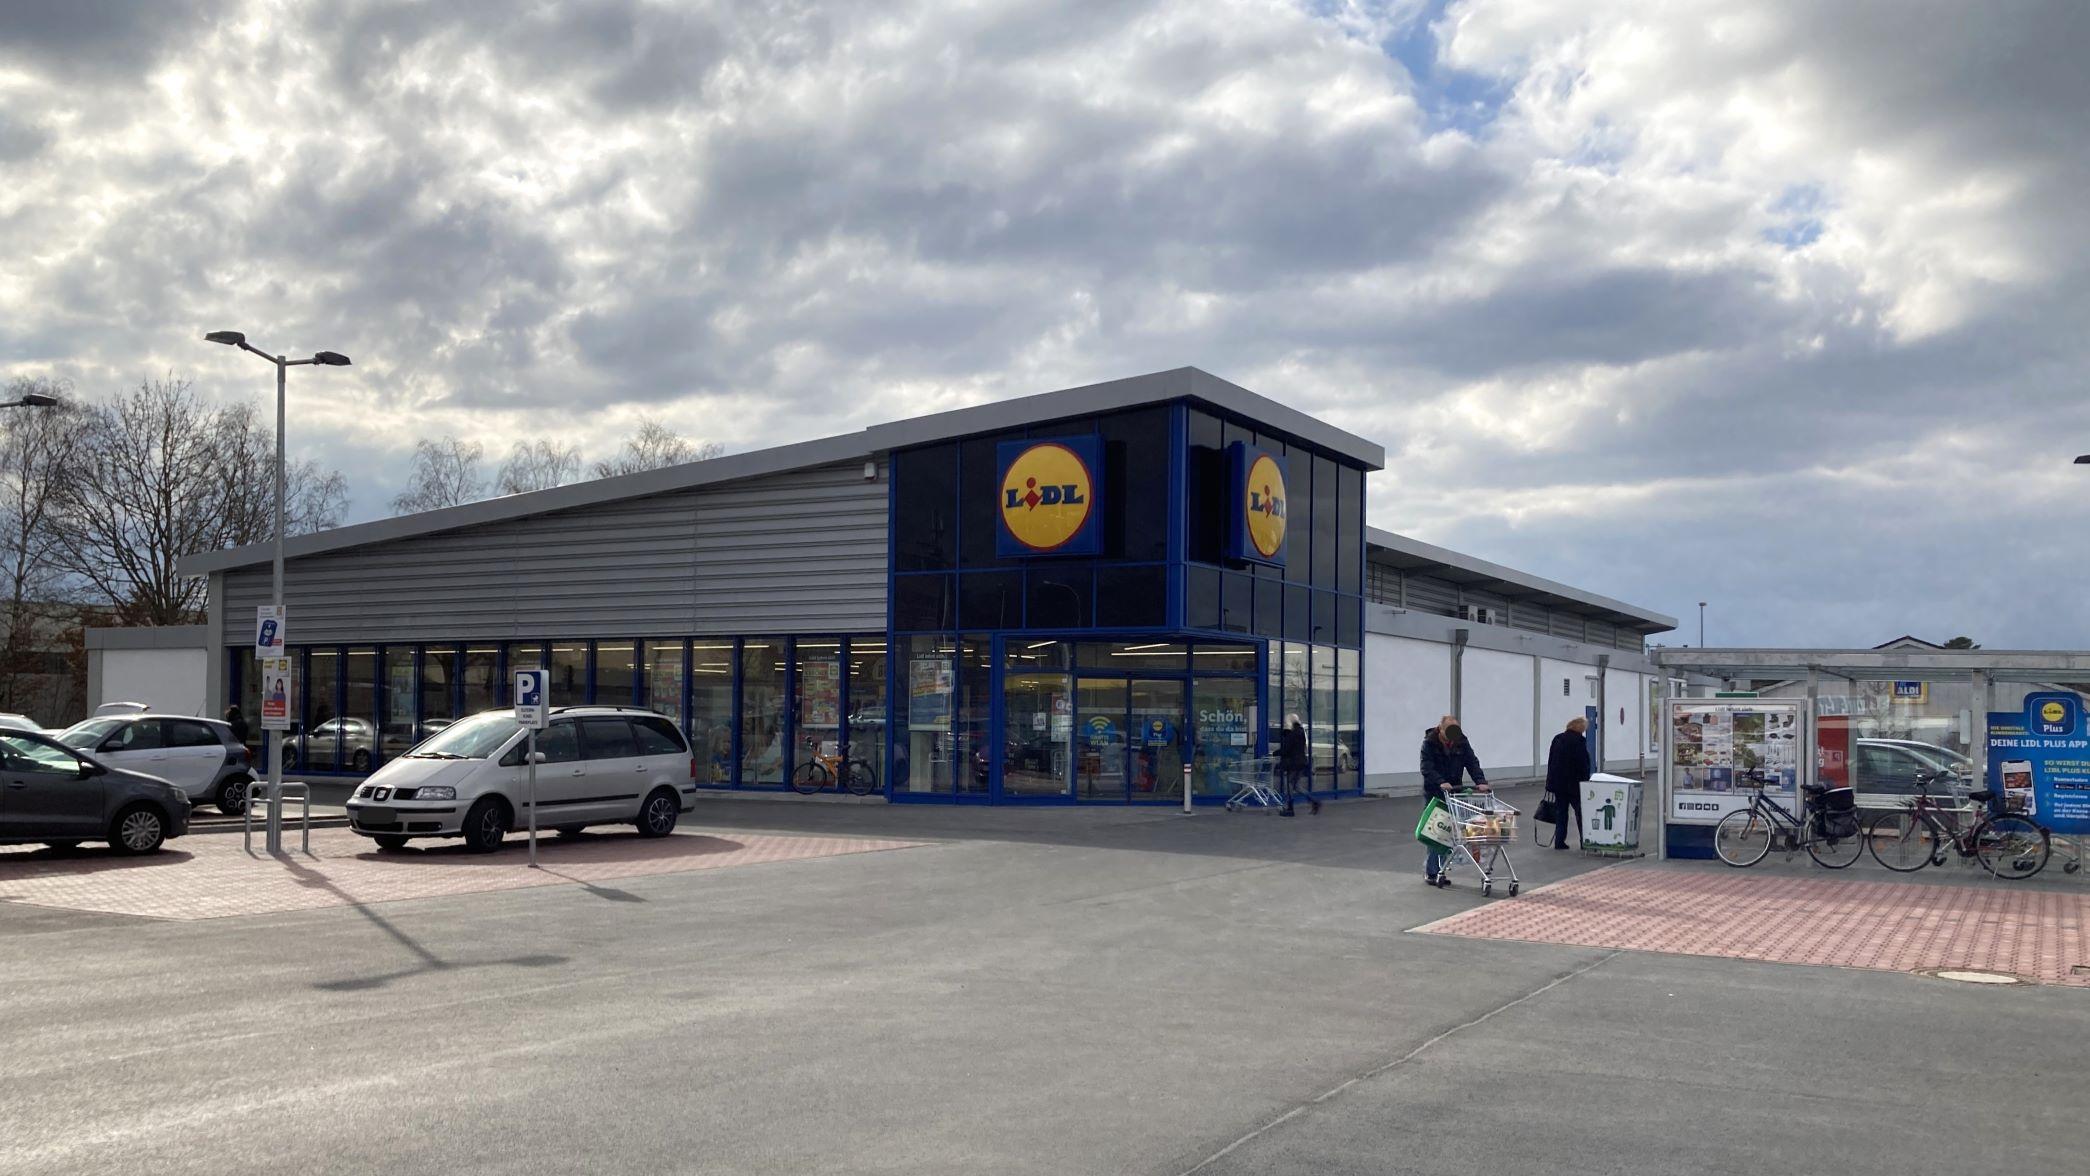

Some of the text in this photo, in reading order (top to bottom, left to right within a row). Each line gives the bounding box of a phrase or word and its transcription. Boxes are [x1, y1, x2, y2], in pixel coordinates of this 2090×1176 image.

[516, 673, 535, 705] P
[1897, 686, 1919, 695] ALDI
[1200, 709, 1248, 725] Schön,
[2043, 724, 2063, 732] Plus
[1990, 739, 2088, 748] DEINE LIDL PLUS APP
